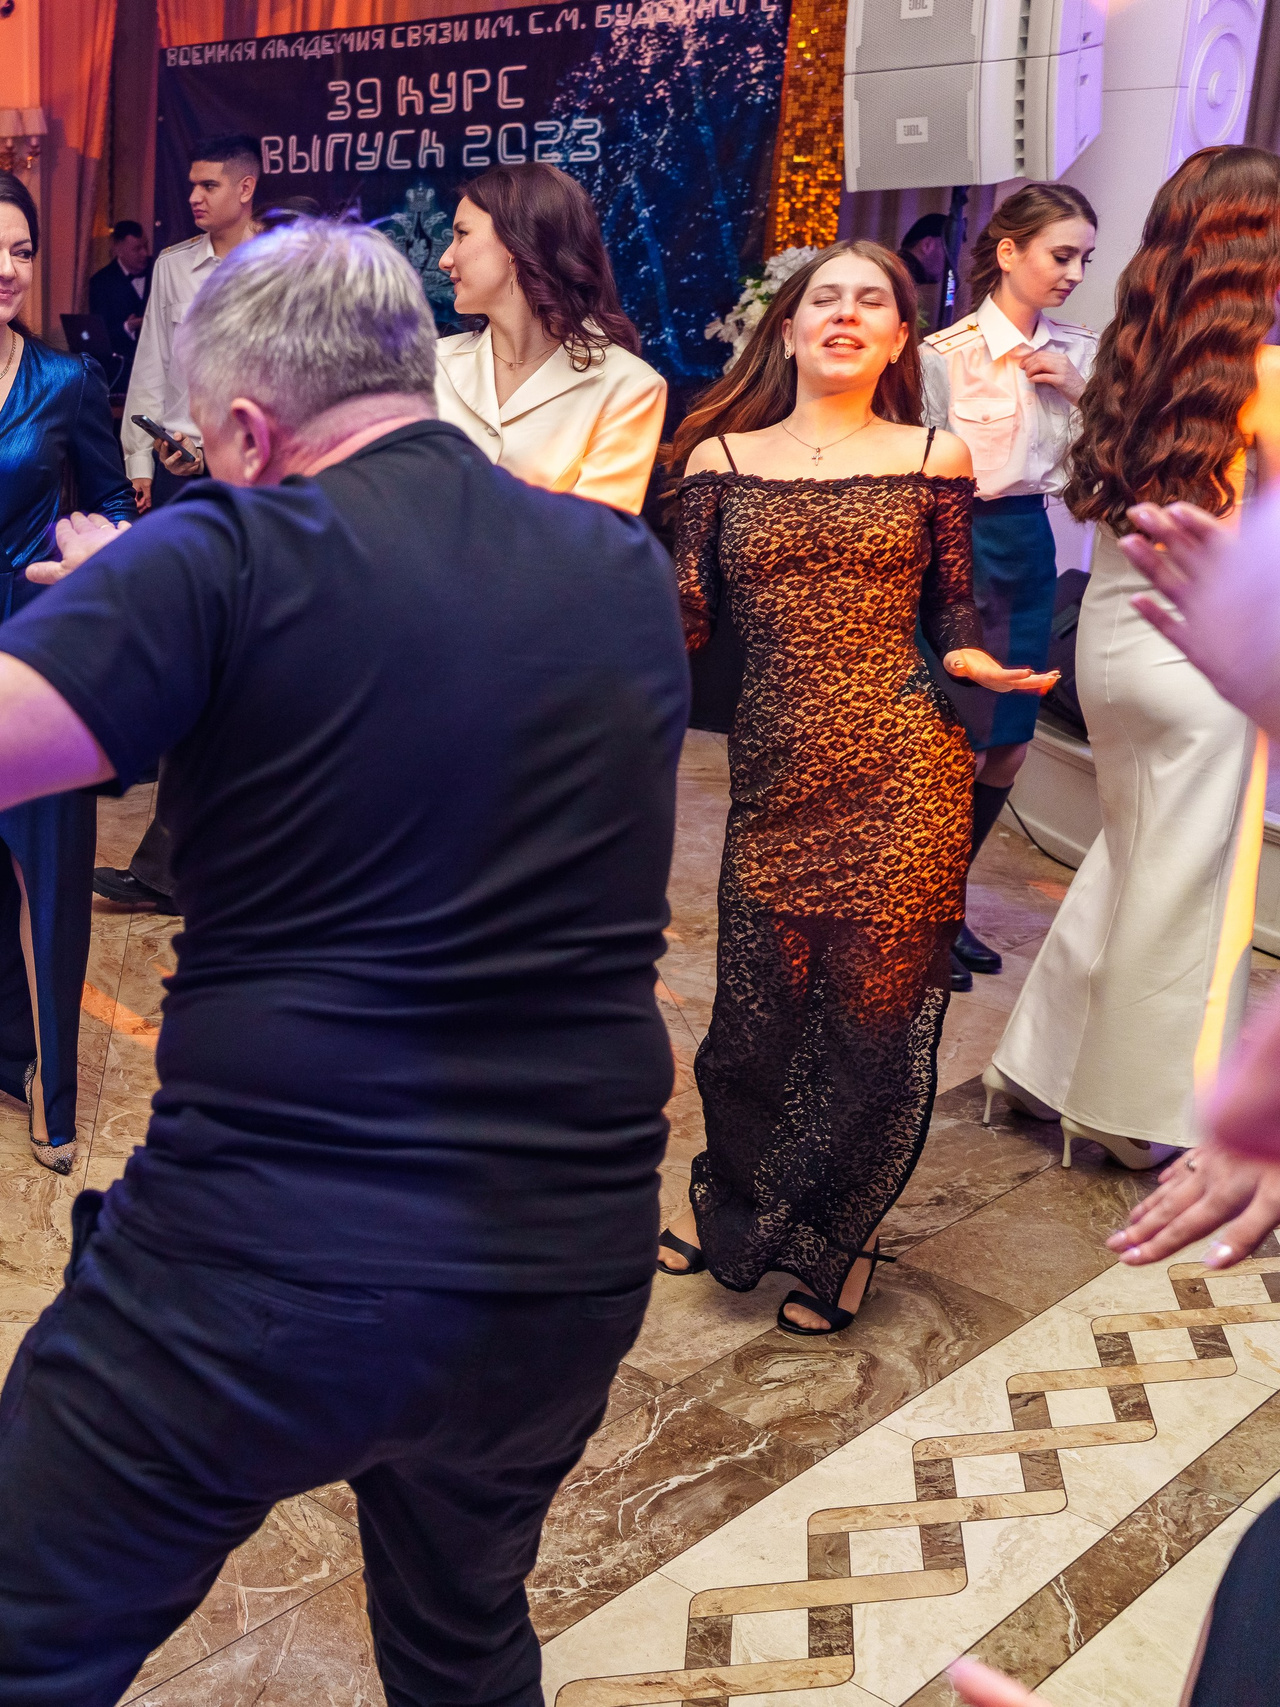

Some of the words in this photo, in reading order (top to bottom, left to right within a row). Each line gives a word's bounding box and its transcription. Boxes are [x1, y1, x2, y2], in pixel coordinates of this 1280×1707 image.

[908, 0, 928, 11] JBL
[166, 41, 258, 67] ВОЕННАЯ
[261, 28, 386, 60] АКАДЕМИЯ
[391, 19, 469, 49] СВЯЗИ
[474, 15, 521, 40] ИМ.
[327, 77, 383, 121] 39
[396, 64, 528, 116] КУРС
[260, 128, 446, 175] ВЫПУСК
[462, 117, 603, 168] 2023
[903, 124, 923, 137] JBL
